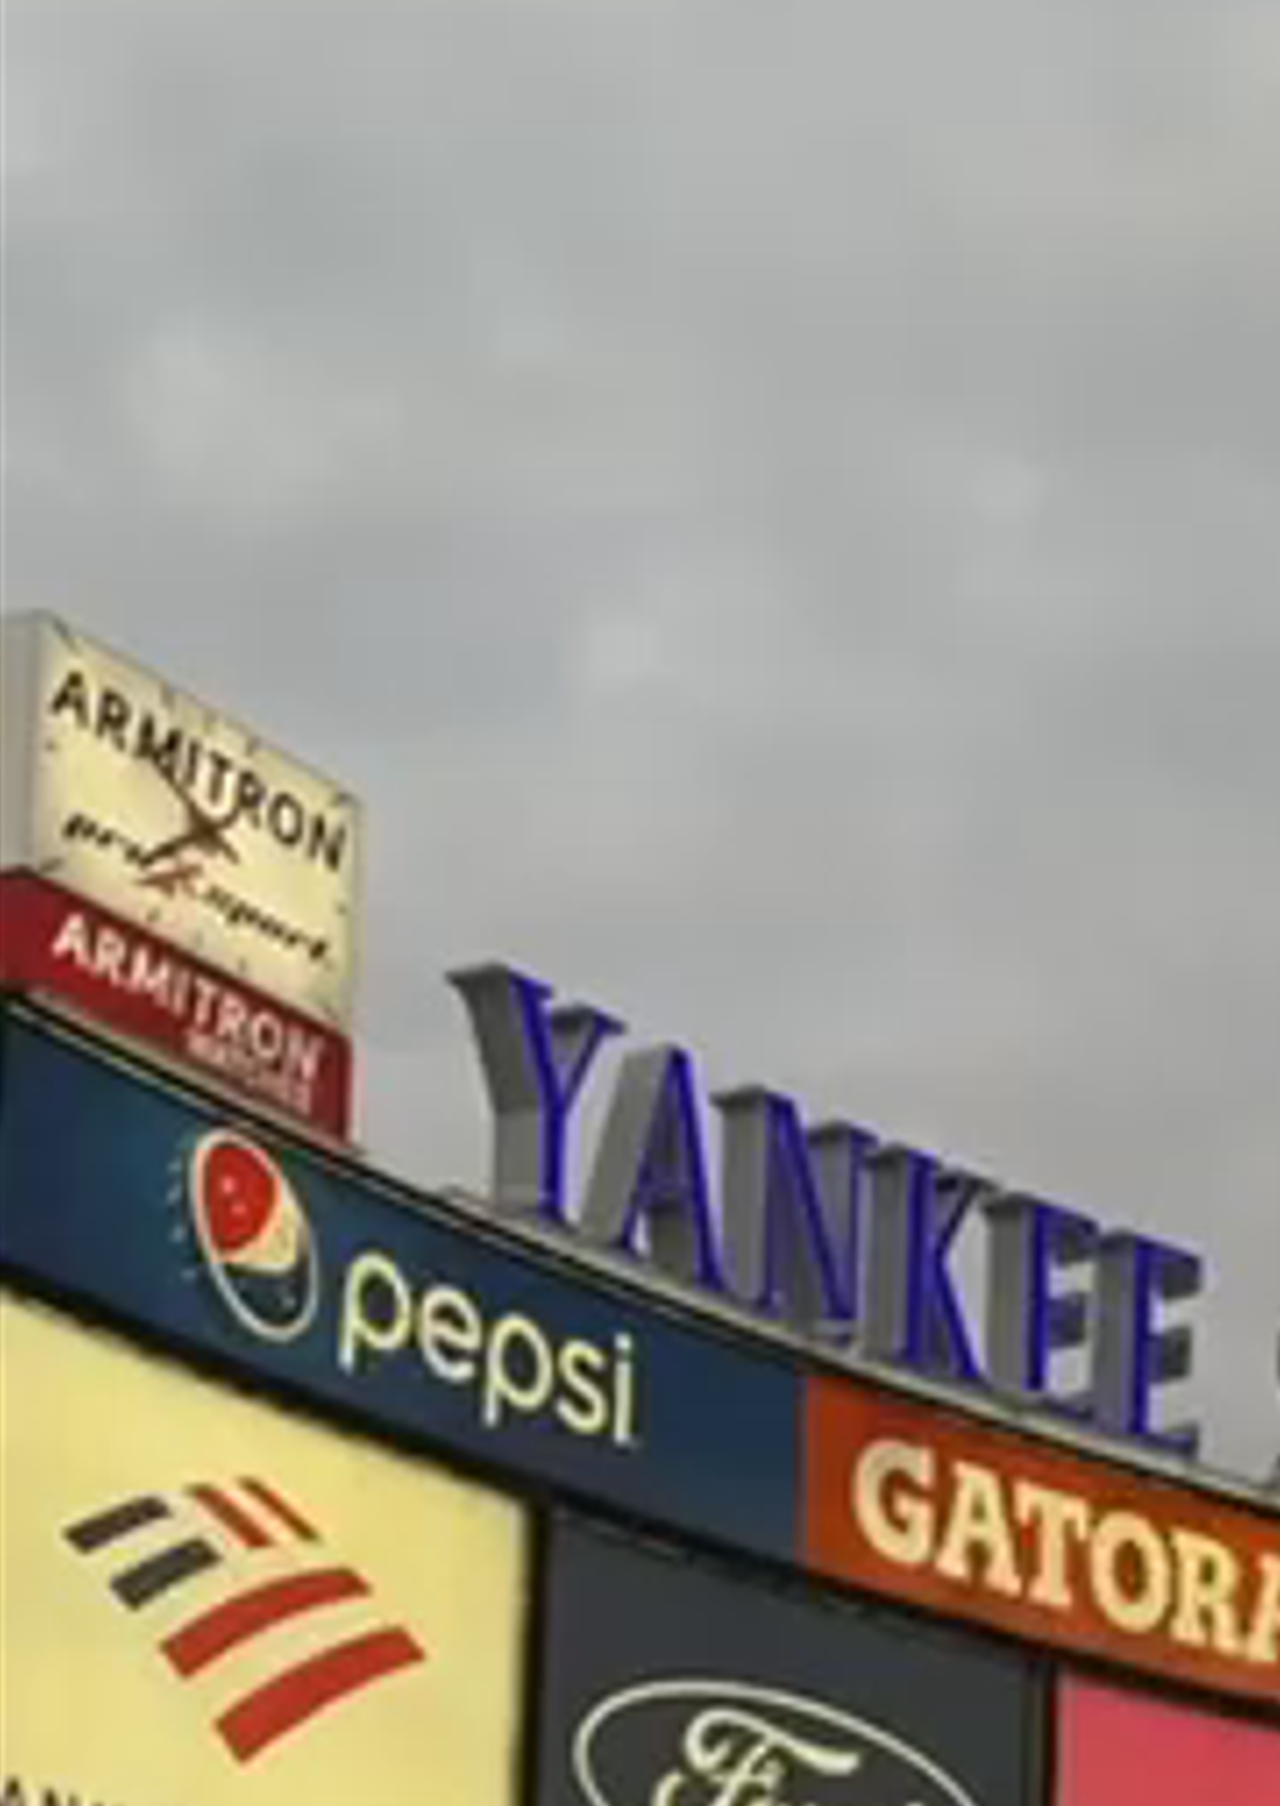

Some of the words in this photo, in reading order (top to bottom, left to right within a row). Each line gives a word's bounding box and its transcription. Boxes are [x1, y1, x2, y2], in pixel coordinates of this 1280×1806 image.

[50, 671, 347, 871] ARMITRON
[52, 912, 322, 1084] ARMITRON
[445, 962, 1200, 1452] YANKEE
[338, 1252, 636, 1446] pepsi
